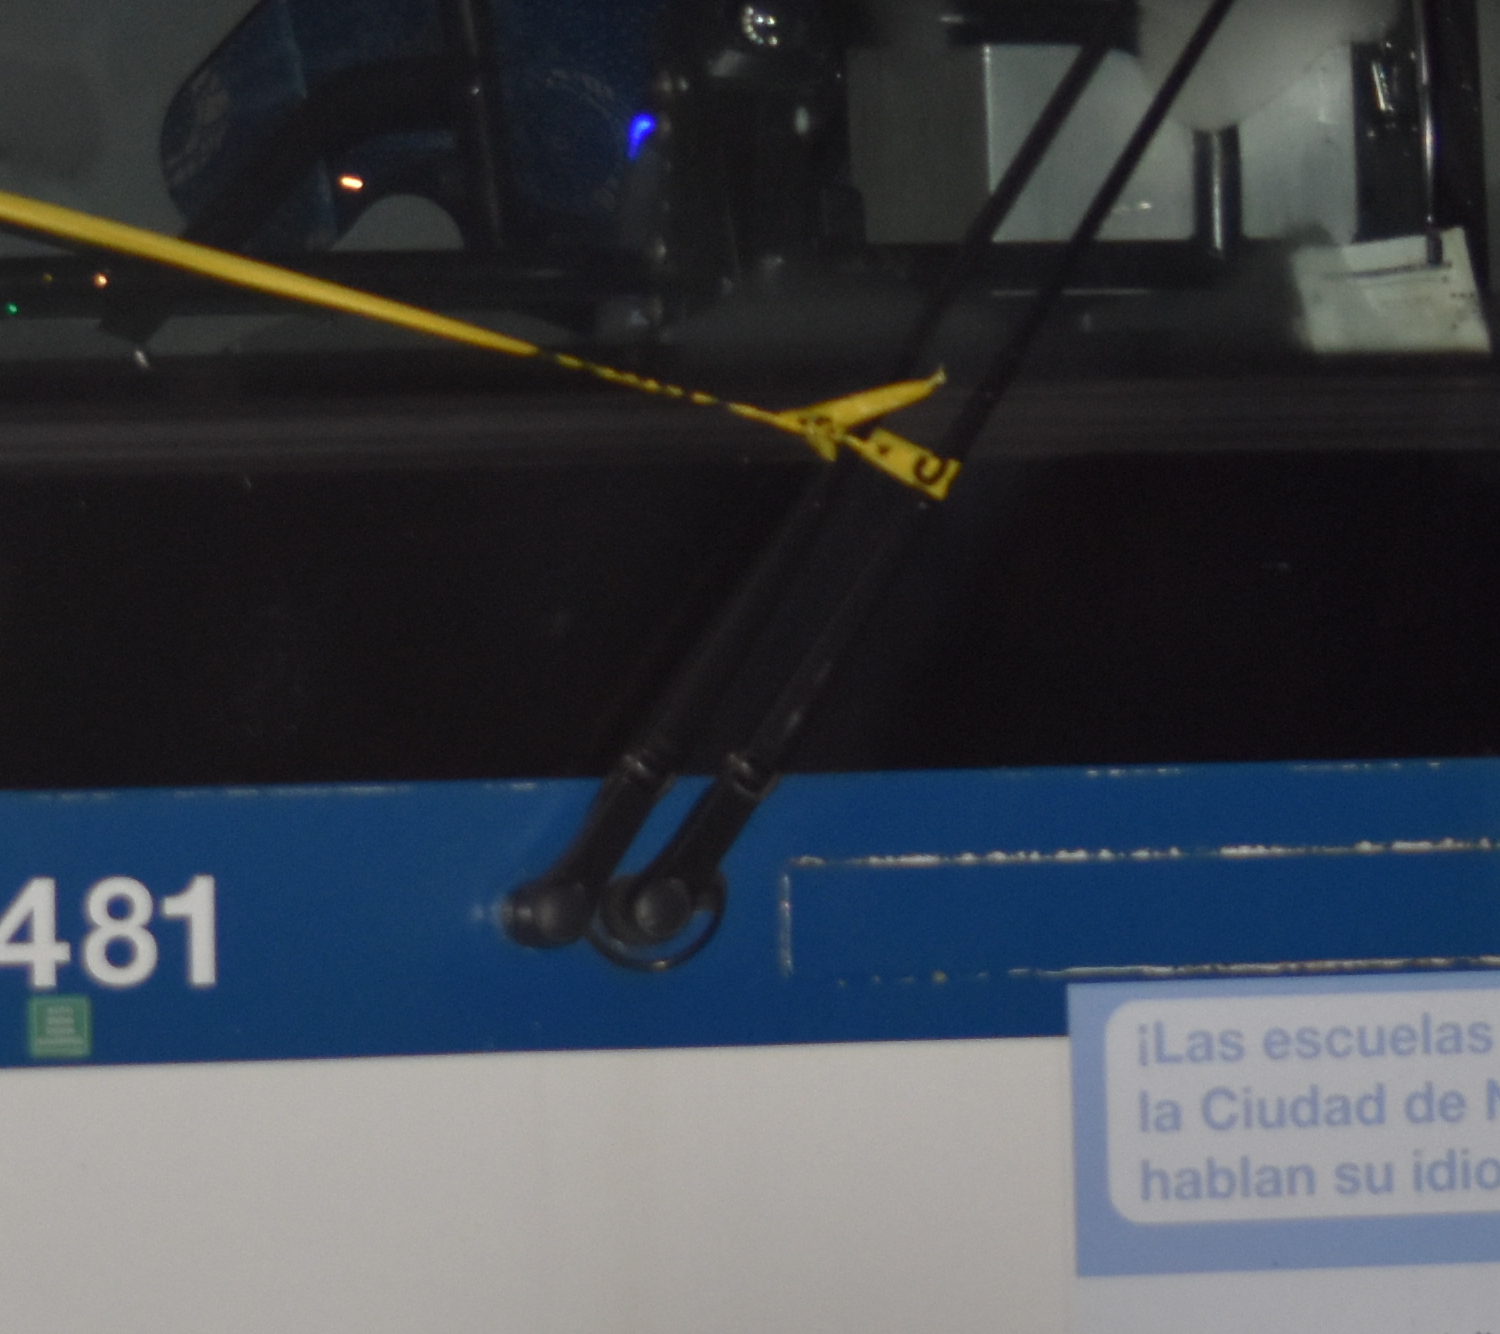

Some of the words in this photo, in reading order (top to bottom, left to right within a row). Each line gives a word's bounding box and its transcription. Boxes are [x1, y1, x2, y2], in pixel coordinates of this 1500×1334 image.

[1137, 1022, 1246, 1067] ¡Las
[1262, 1013, 1493, 1060] escuelas
[1139, 1091, 1182, 1133] la
[1201, 1084, 1386, 1131] Ciudad
[1405, 1083, 1466, 1124] de
[1139, 1157, 1315, 1201] hablan
[1334, 1161, 1393, 1197] su
